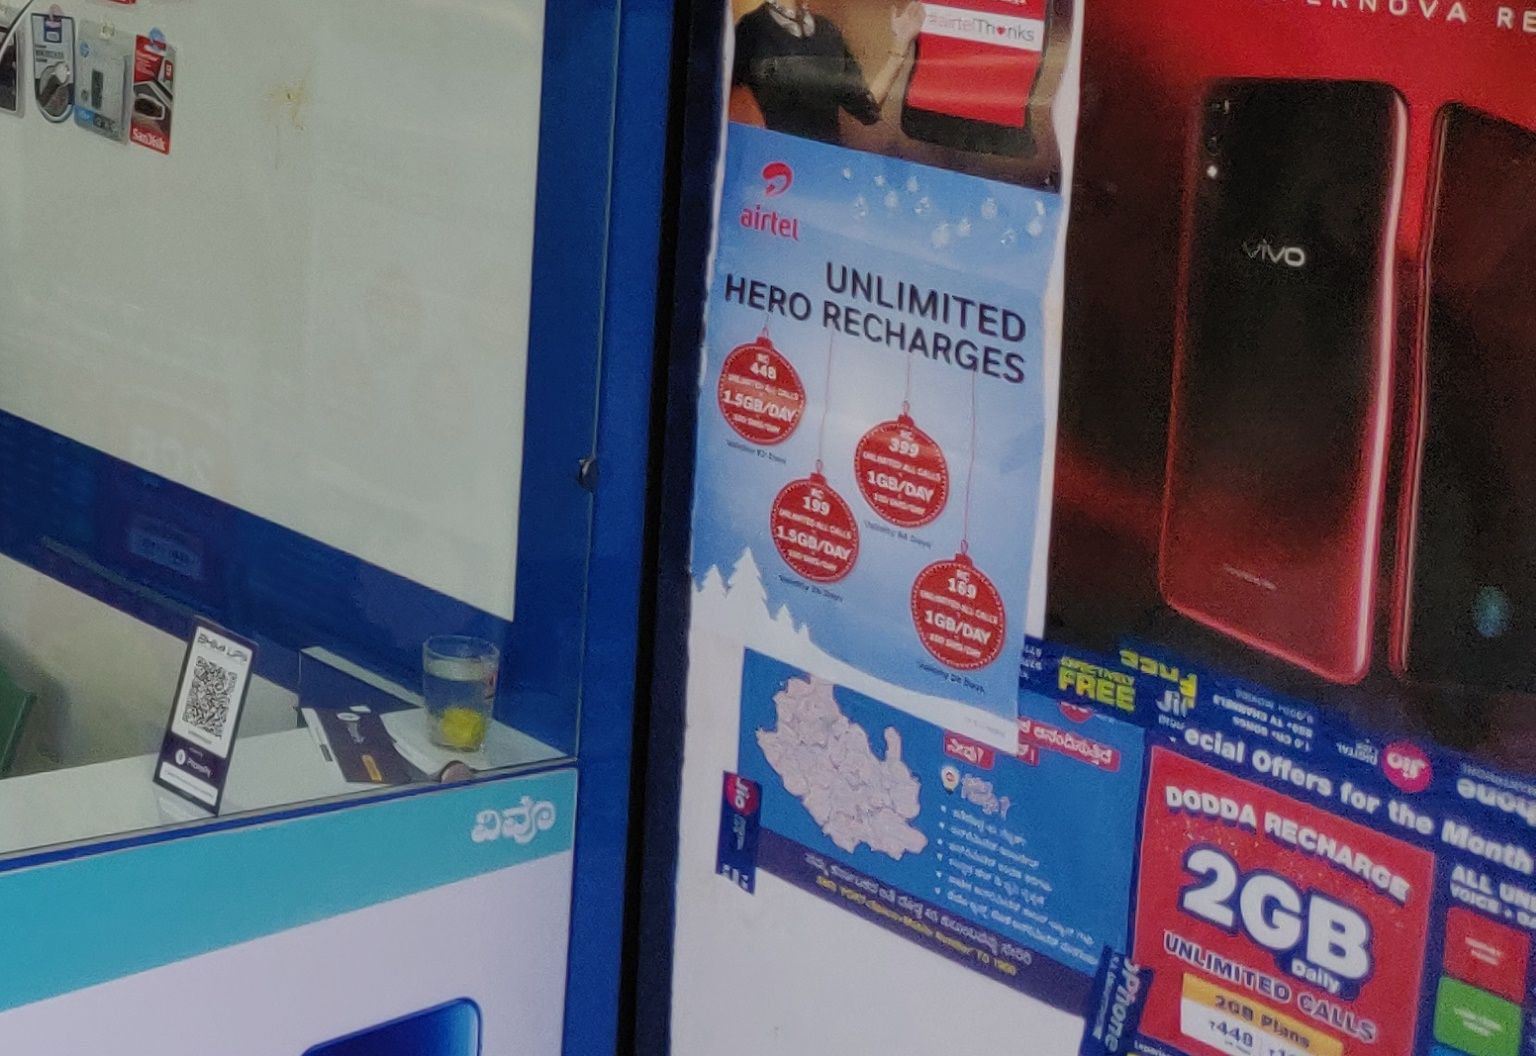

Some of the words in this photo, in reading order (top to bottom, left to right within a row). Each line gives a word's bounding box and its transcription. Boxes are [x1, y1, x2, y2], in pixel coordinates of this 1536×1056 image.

[740, 204, 799, 241] airtel
[725, 274, 812, 321] HERO
[823, 301, 1026, 384] RECHARGES
[826, 262, 1027, 343] UNLIMITED
[1058, 667, 1135, 712] FREE
[1164, 784, 1259, 830] DODDA
[1264, 810, 1412, 903] RECHARGE
[1184, 728, 1246, 764] ecial
[1253, 747, 1332, 797] Offers
[1340, 782, 1381, 814] for
[1388, 798, 1434, 835] the
[1441, 820, 1534, 875] Month
[1181, 847, 1372, 981] 2GB
[1164, 929, 1292, 1004] UNLIMITED
[1297, 991, 1377, 1043] CALLS
[1215, 995, 1254, 1022] 2GB
[1291, 957, 1342, 994] Daily
